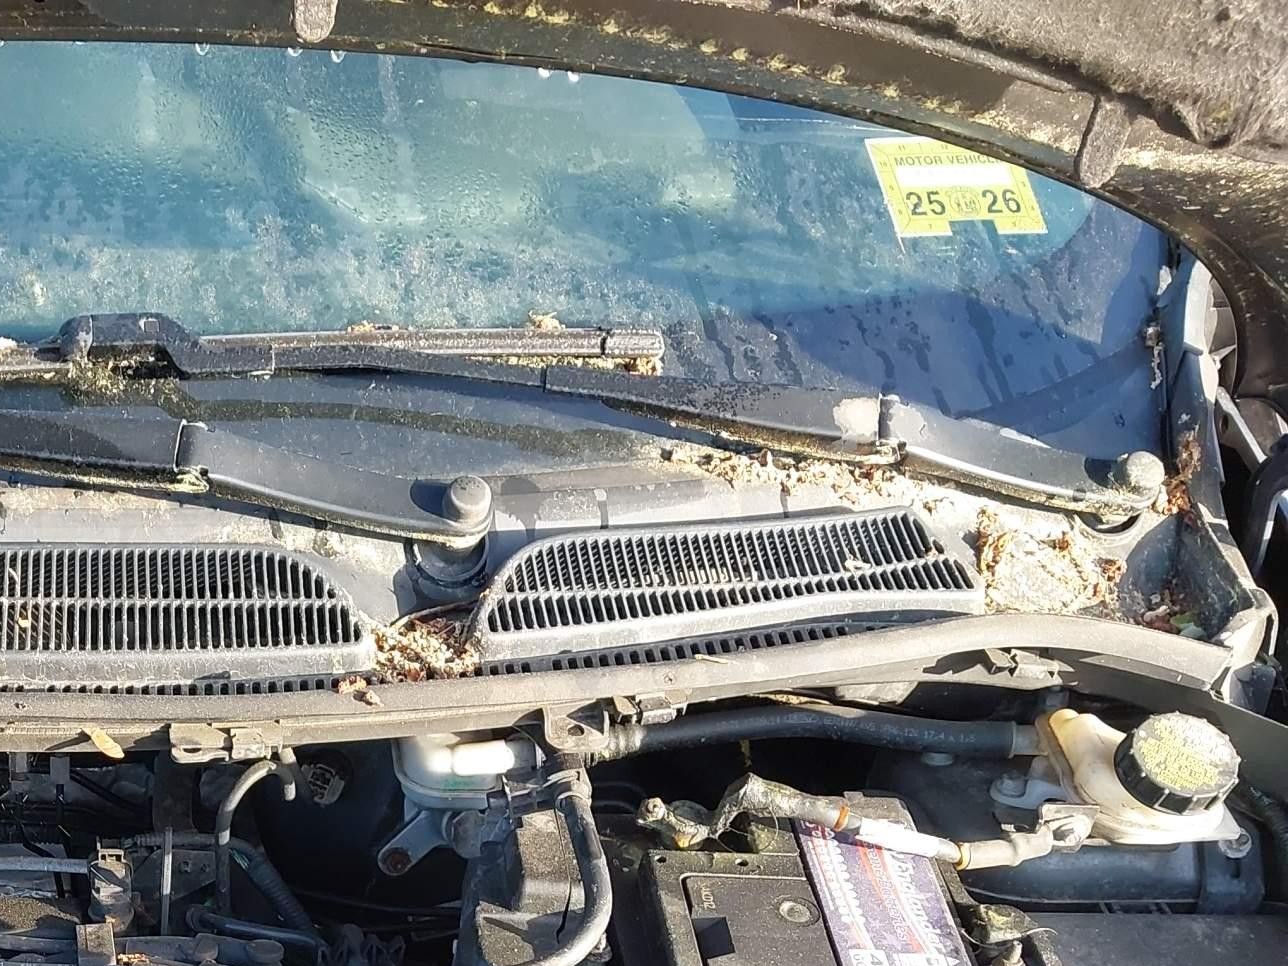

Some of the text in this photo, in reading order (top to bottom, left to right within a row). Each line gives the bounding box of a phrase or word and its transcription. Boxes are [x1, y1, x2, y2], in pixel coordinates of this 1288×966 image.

[895, 153, 1001, 166] MOTOR VEHICL
[906, 191, 946, 215] 25
[981, 189, 1021, 214] 26
[878, 880, 909, 941] Batteries
